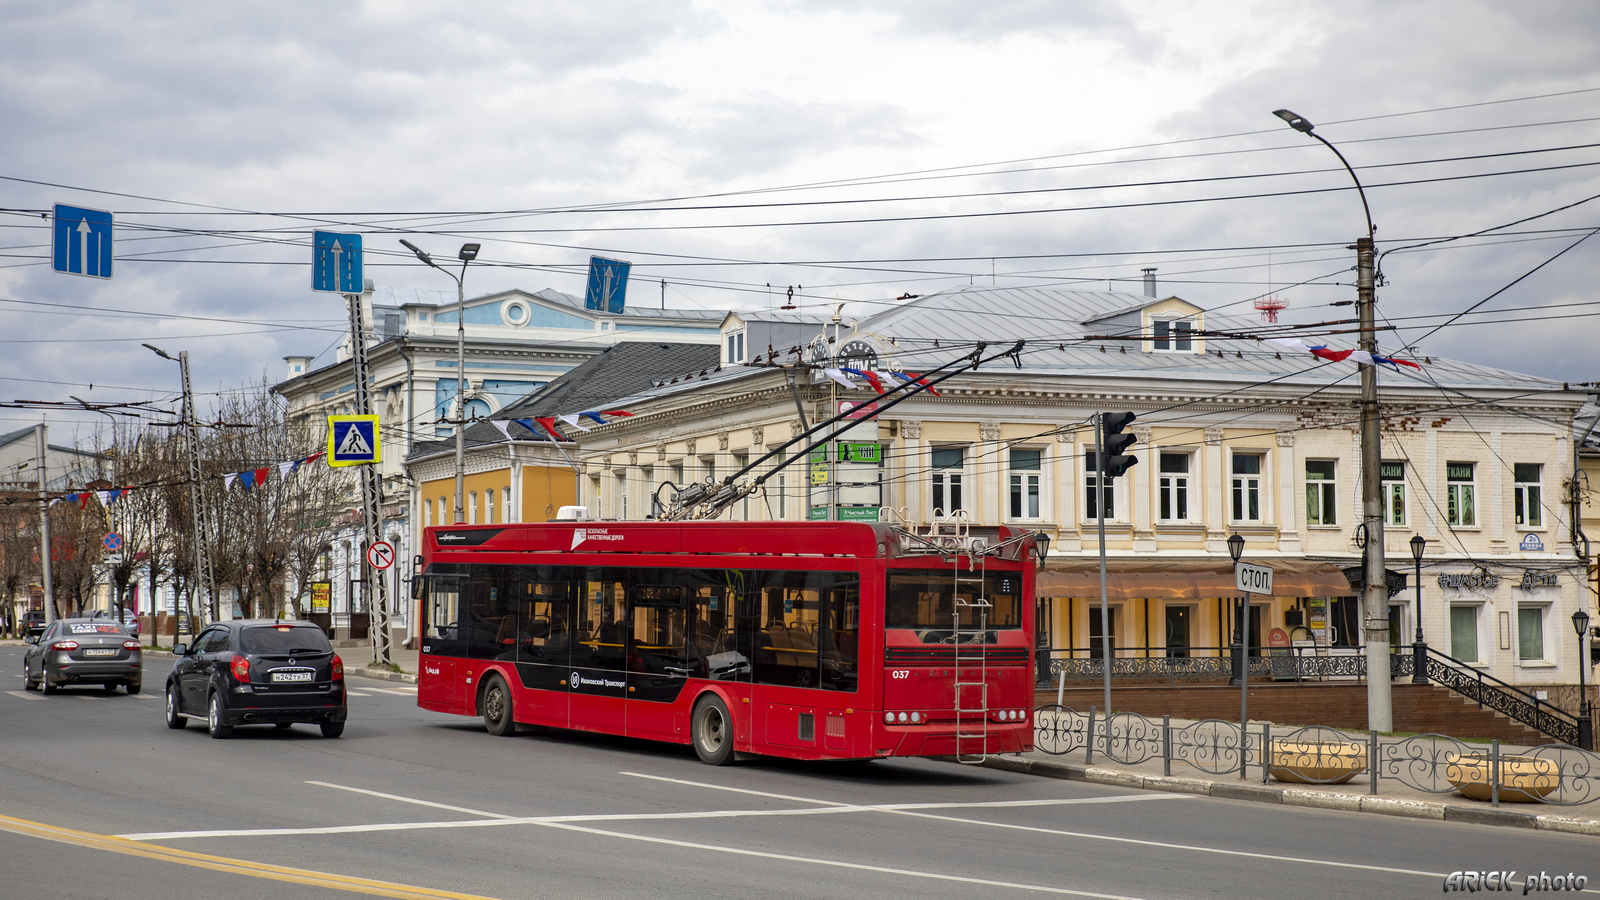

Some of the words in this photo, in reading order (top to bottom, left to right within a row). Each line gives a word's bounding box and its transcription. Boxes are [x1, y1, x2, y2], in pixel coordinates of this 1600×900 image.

[1381, 465, 1402, 477] КАНИ
[1394, 486, 1402, 523] САЛОН
[1241, 568, 1269, 589] СТОП
[1521, 573, 1558, 591] ДЕТИ
[892, 670, 910, 679] 037
